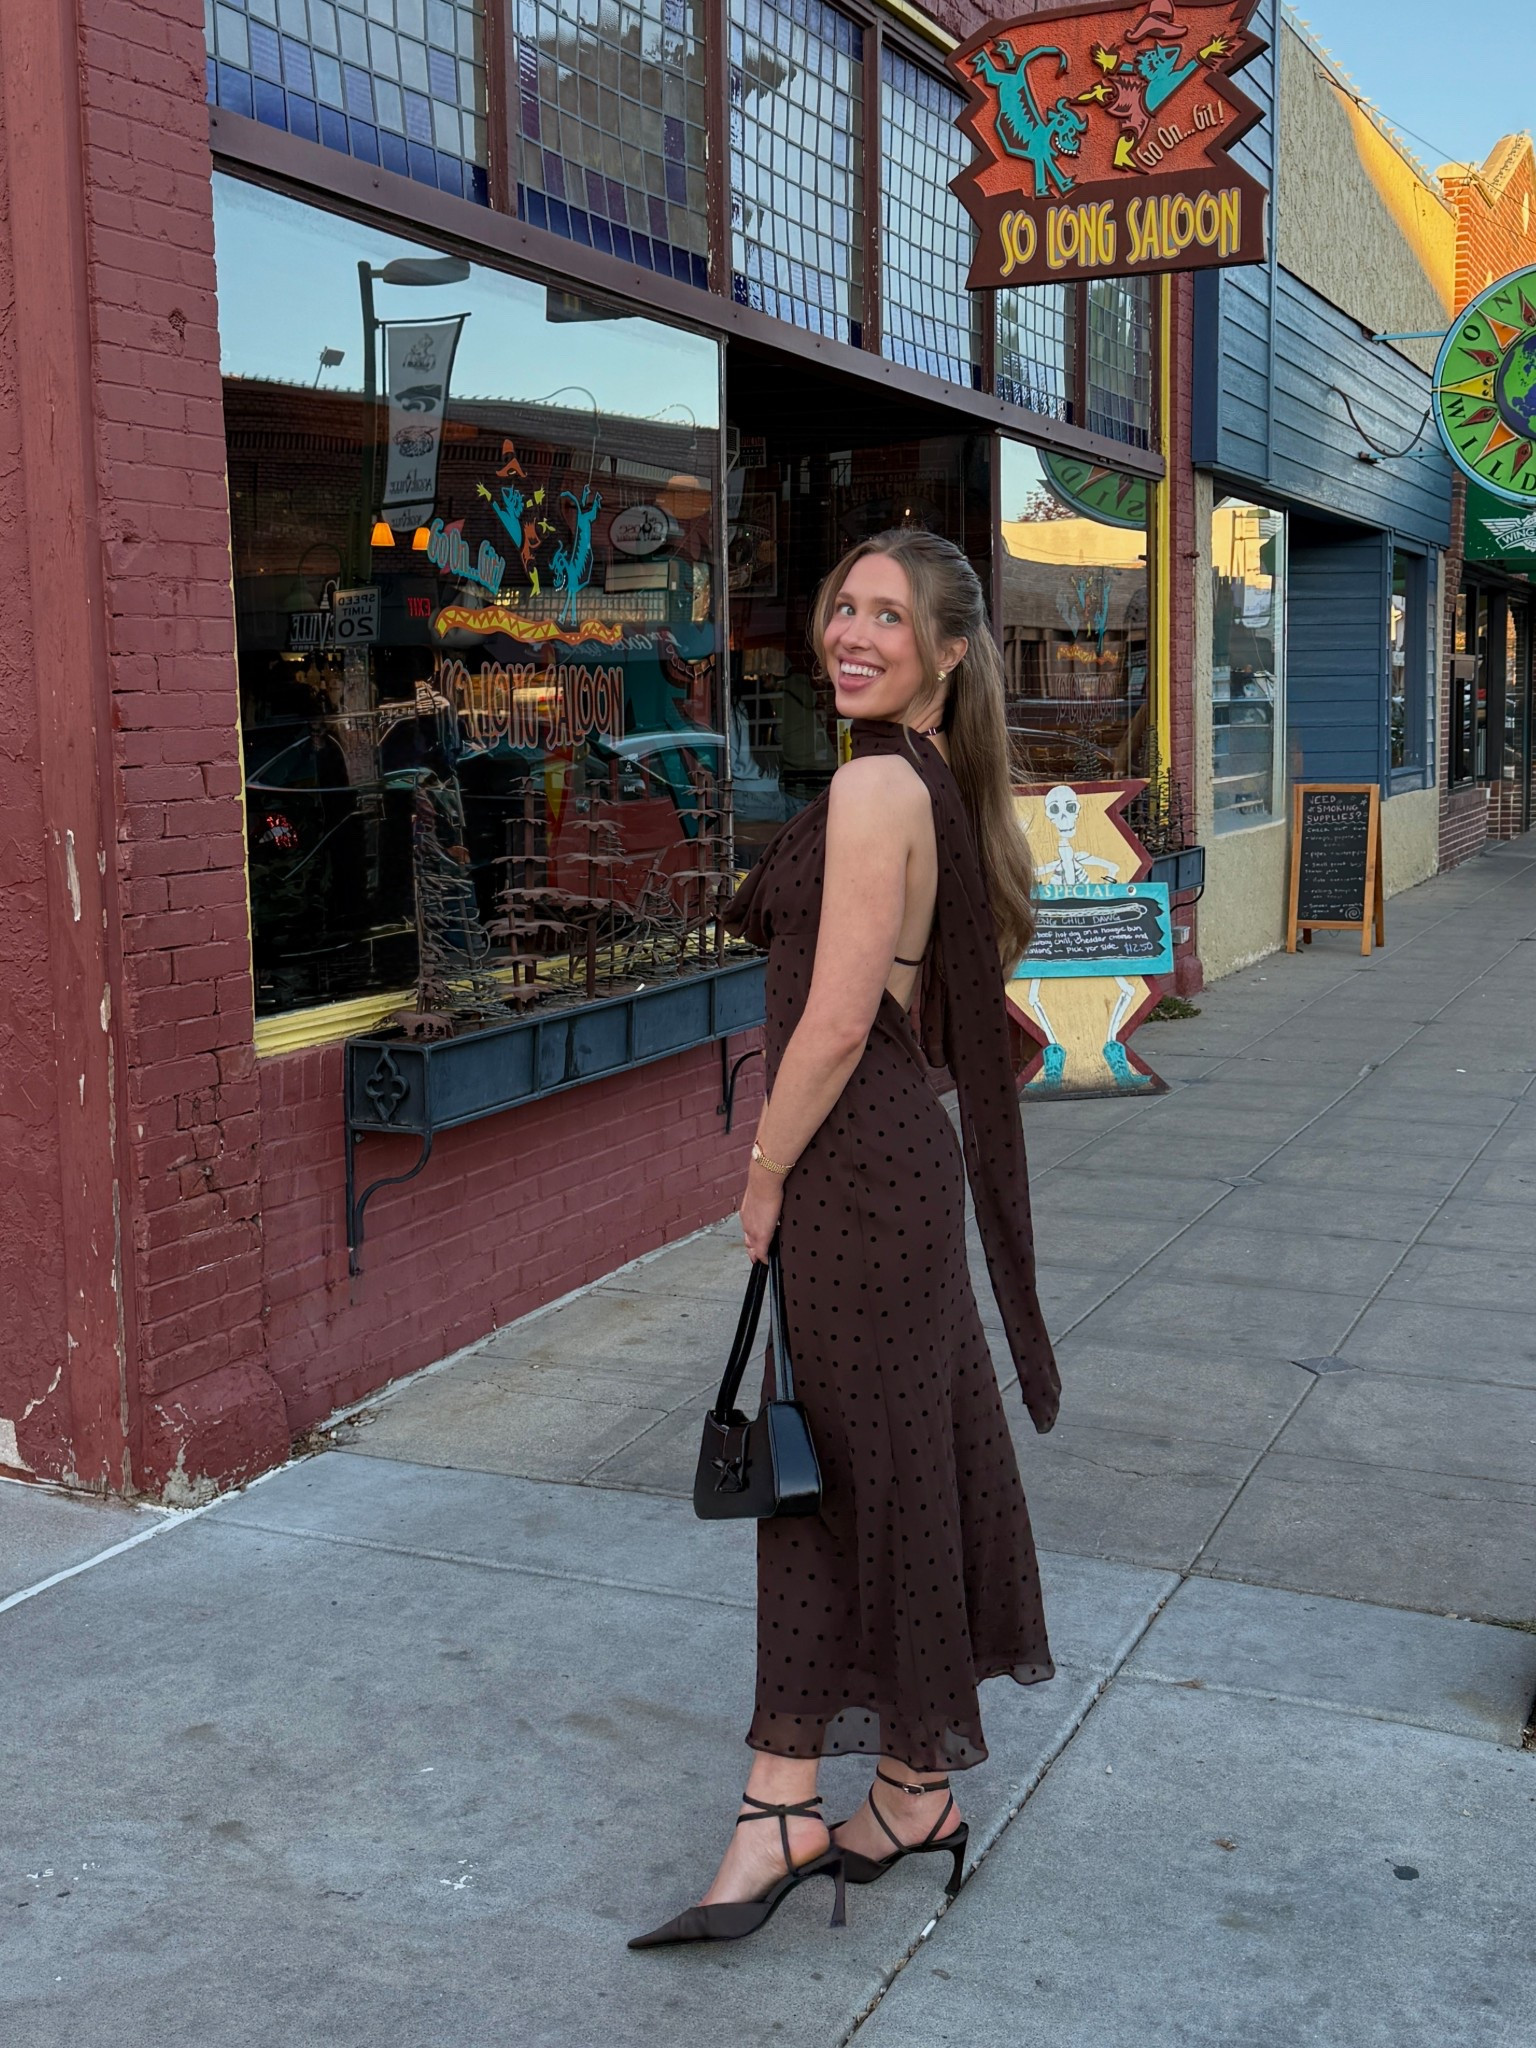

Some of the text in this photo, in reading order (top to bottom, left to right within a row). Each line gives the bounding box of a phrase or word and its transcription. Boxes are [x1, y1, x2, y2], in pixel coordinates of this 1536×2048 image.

[999, 187, 1242, 278] SO LONG SALOON
[545, 664, 625, 750] SALOON
[1309, 795, 1336, 805] NEED
[1317, 804, 1359, 813] SMOKING
[1306, 811, 1362, 823] SUPPLIES?
[1043, 884, 1114, 898] SPECIAL
[1061, 915, 1086, 926] CHILI
[1093, 913, 1121, 925] DAWG
[1068, 930, 1082, 939] dog
[1100, 942, 1119, 951] side
